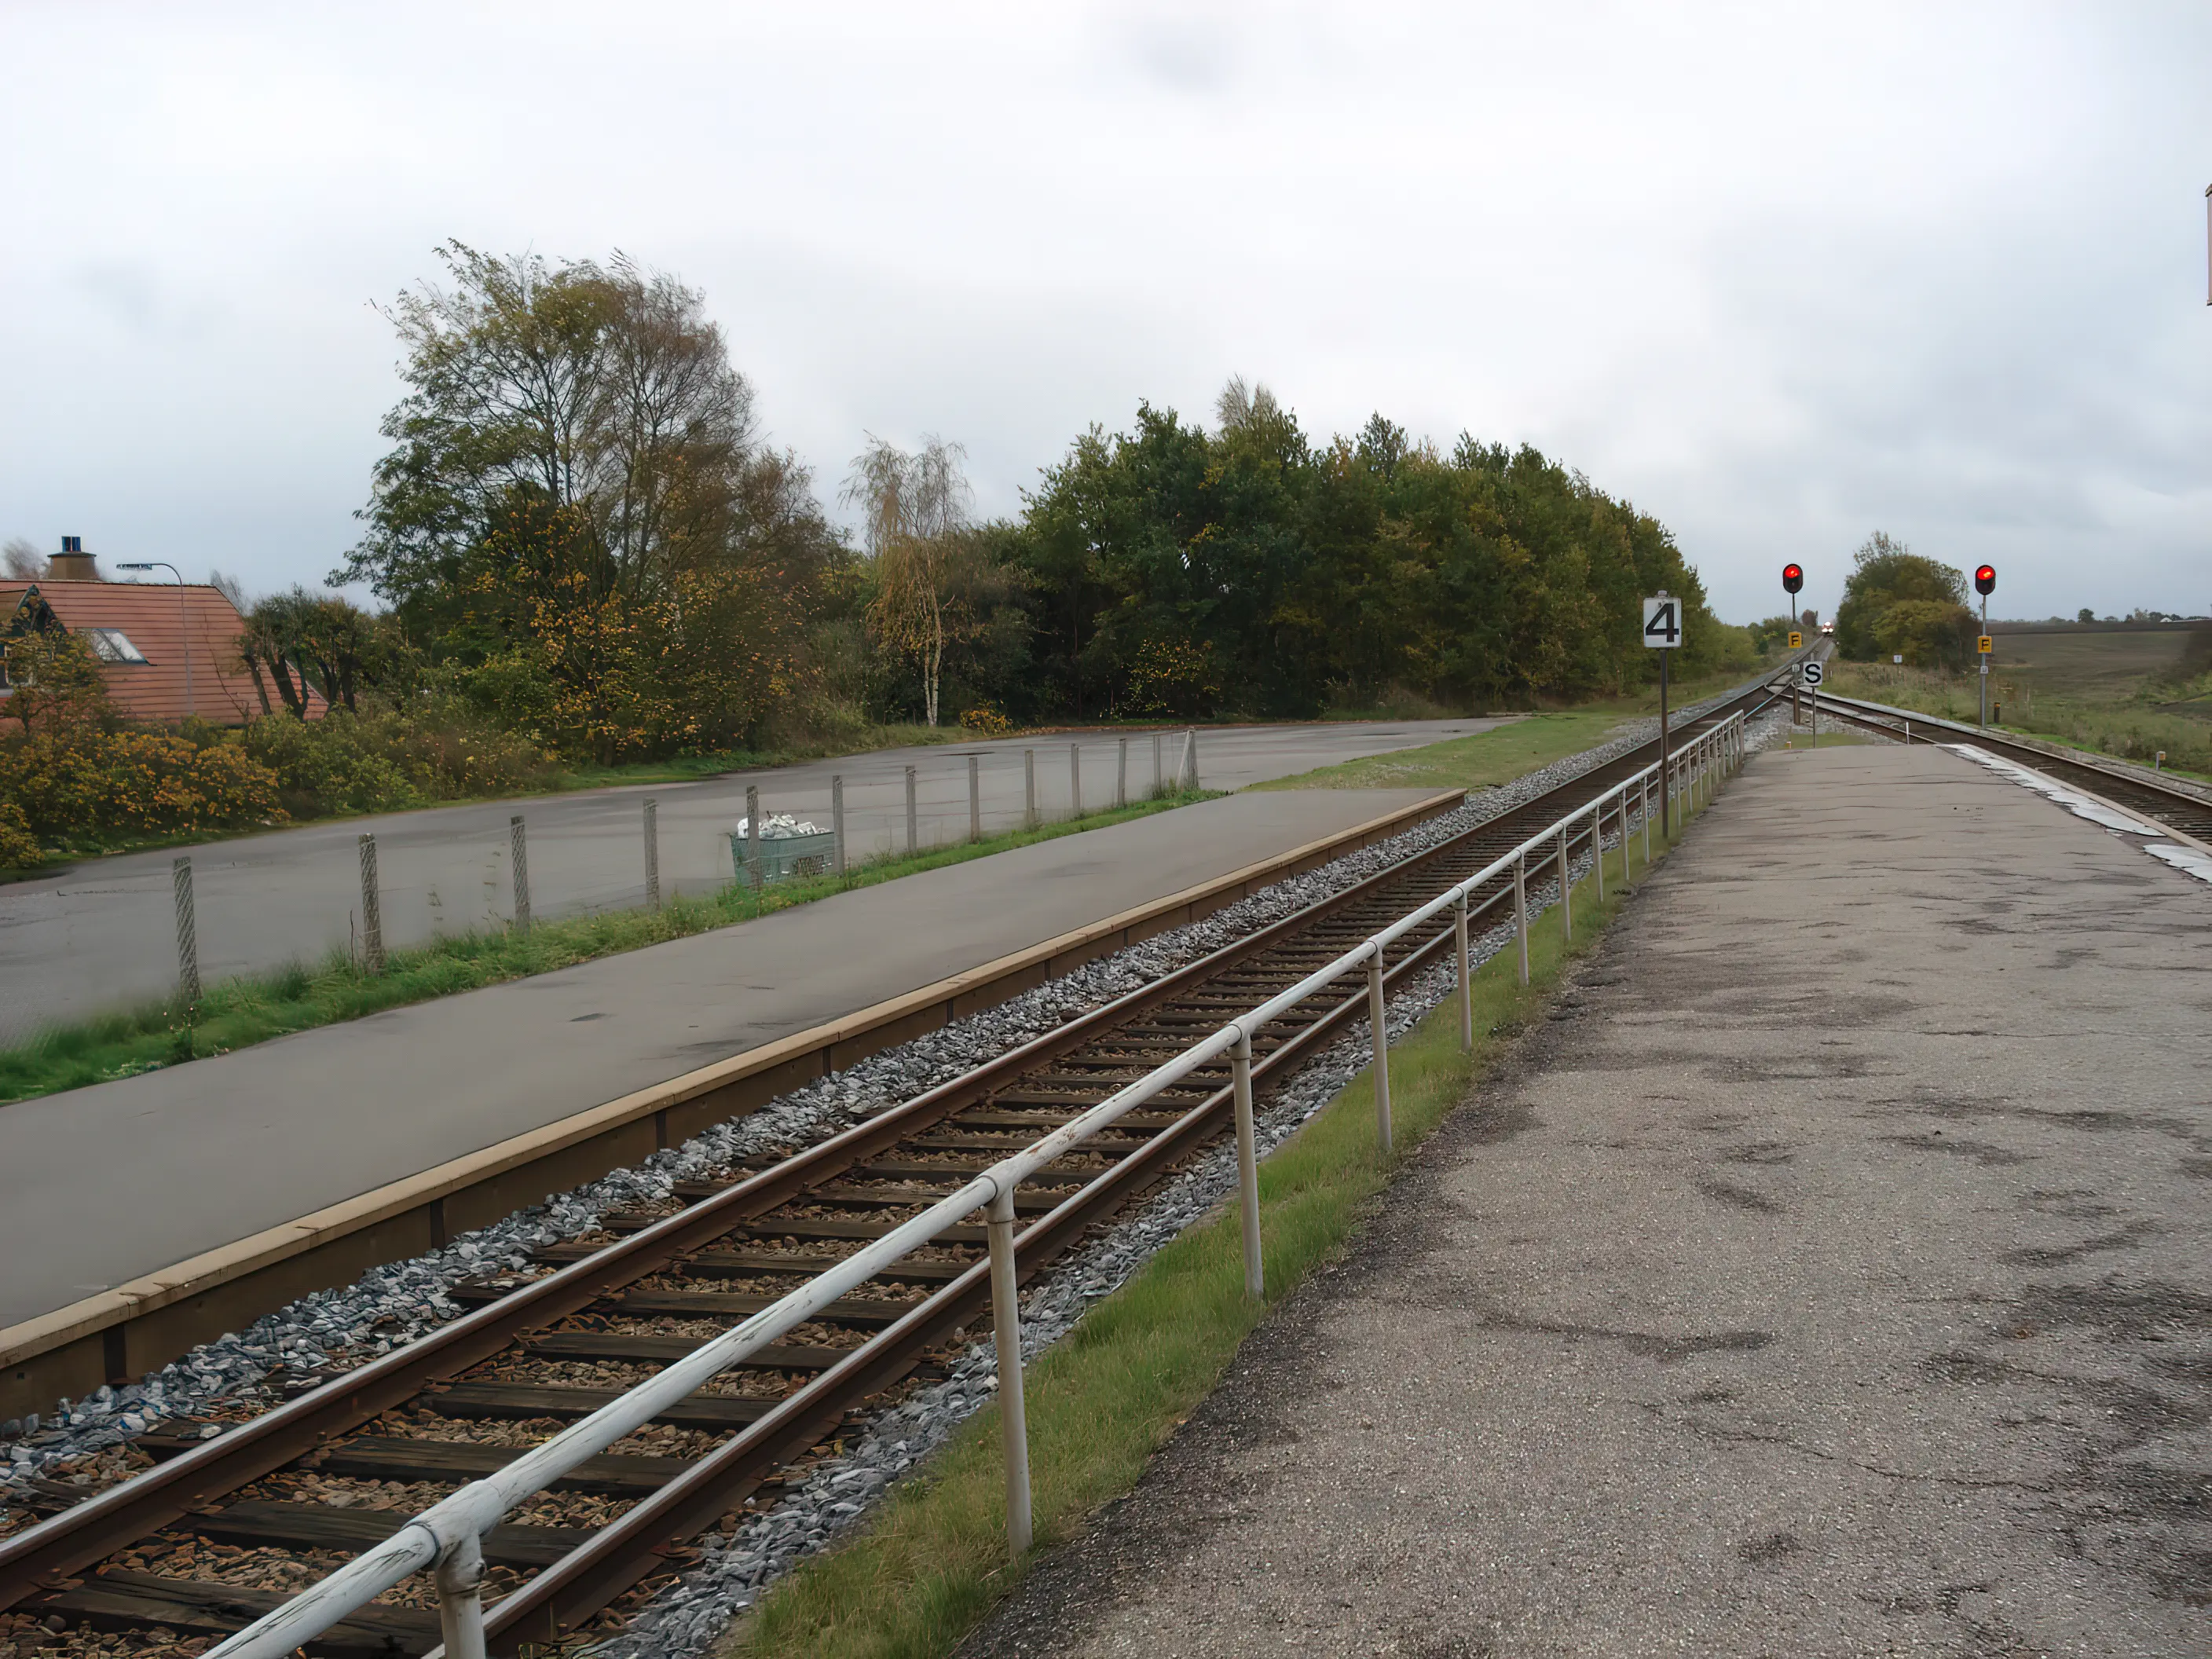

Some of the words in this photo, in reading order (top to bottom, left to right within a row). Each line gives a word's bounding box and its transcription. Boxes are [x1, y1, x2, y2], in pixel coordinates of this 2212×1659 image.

[1646, 603, 1679, 643] 4
[1791, 635, 1799, 646] F
[1981, 639, 1989, 650] F
[1805, 663, 1822, 683] S
